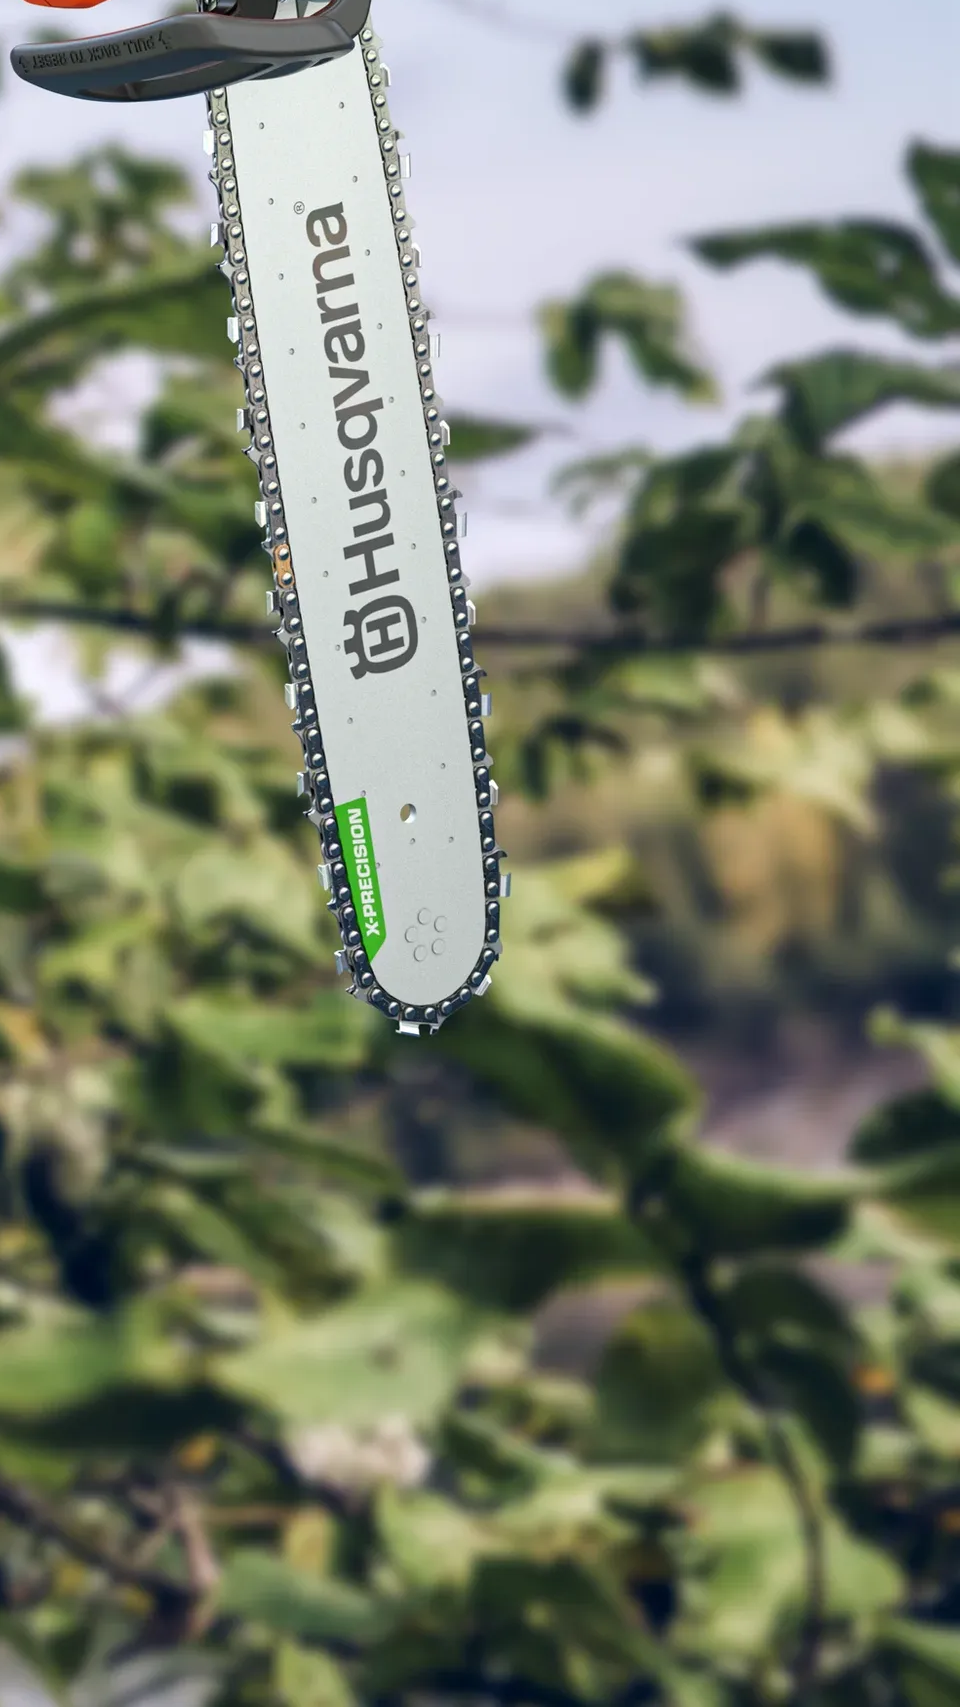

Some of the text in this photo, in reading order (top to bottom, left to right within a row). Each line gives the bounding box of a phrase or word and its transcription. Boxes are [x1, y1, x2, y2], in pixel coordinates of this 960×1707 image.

[32, 53, 68, 69] RESET
[69, 50, 87, 64] TO
[88, 44, 122, 62] BACK
[347, 808, 381, 937] X-PRECISION
